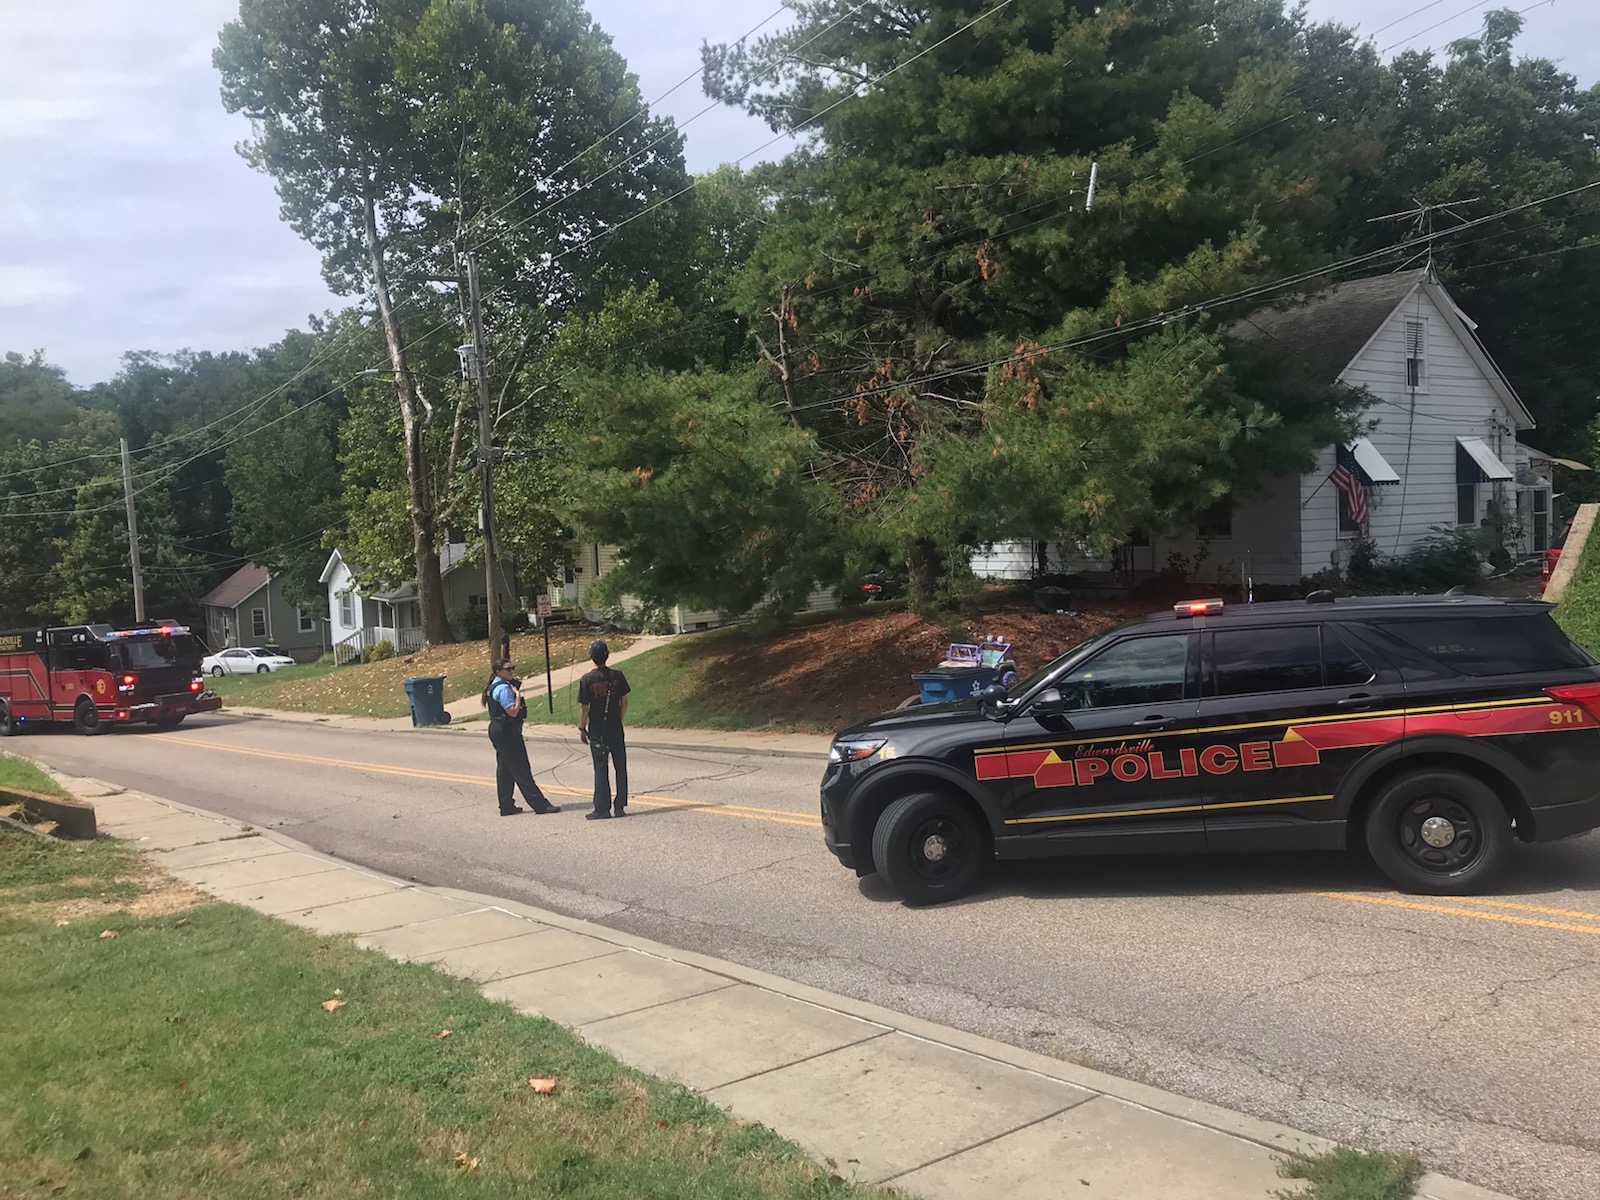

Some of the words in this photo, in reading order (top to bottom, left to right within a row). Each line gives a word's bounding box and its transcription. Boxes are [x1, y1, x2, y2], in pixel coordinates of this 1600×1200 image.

[1549, 709, 1583, 724] 911
[877, 746, 896, 759] 15
[1074, 739, 1156, 758] Edwardsville
[1075, 740, 1273, 787] POLICE
